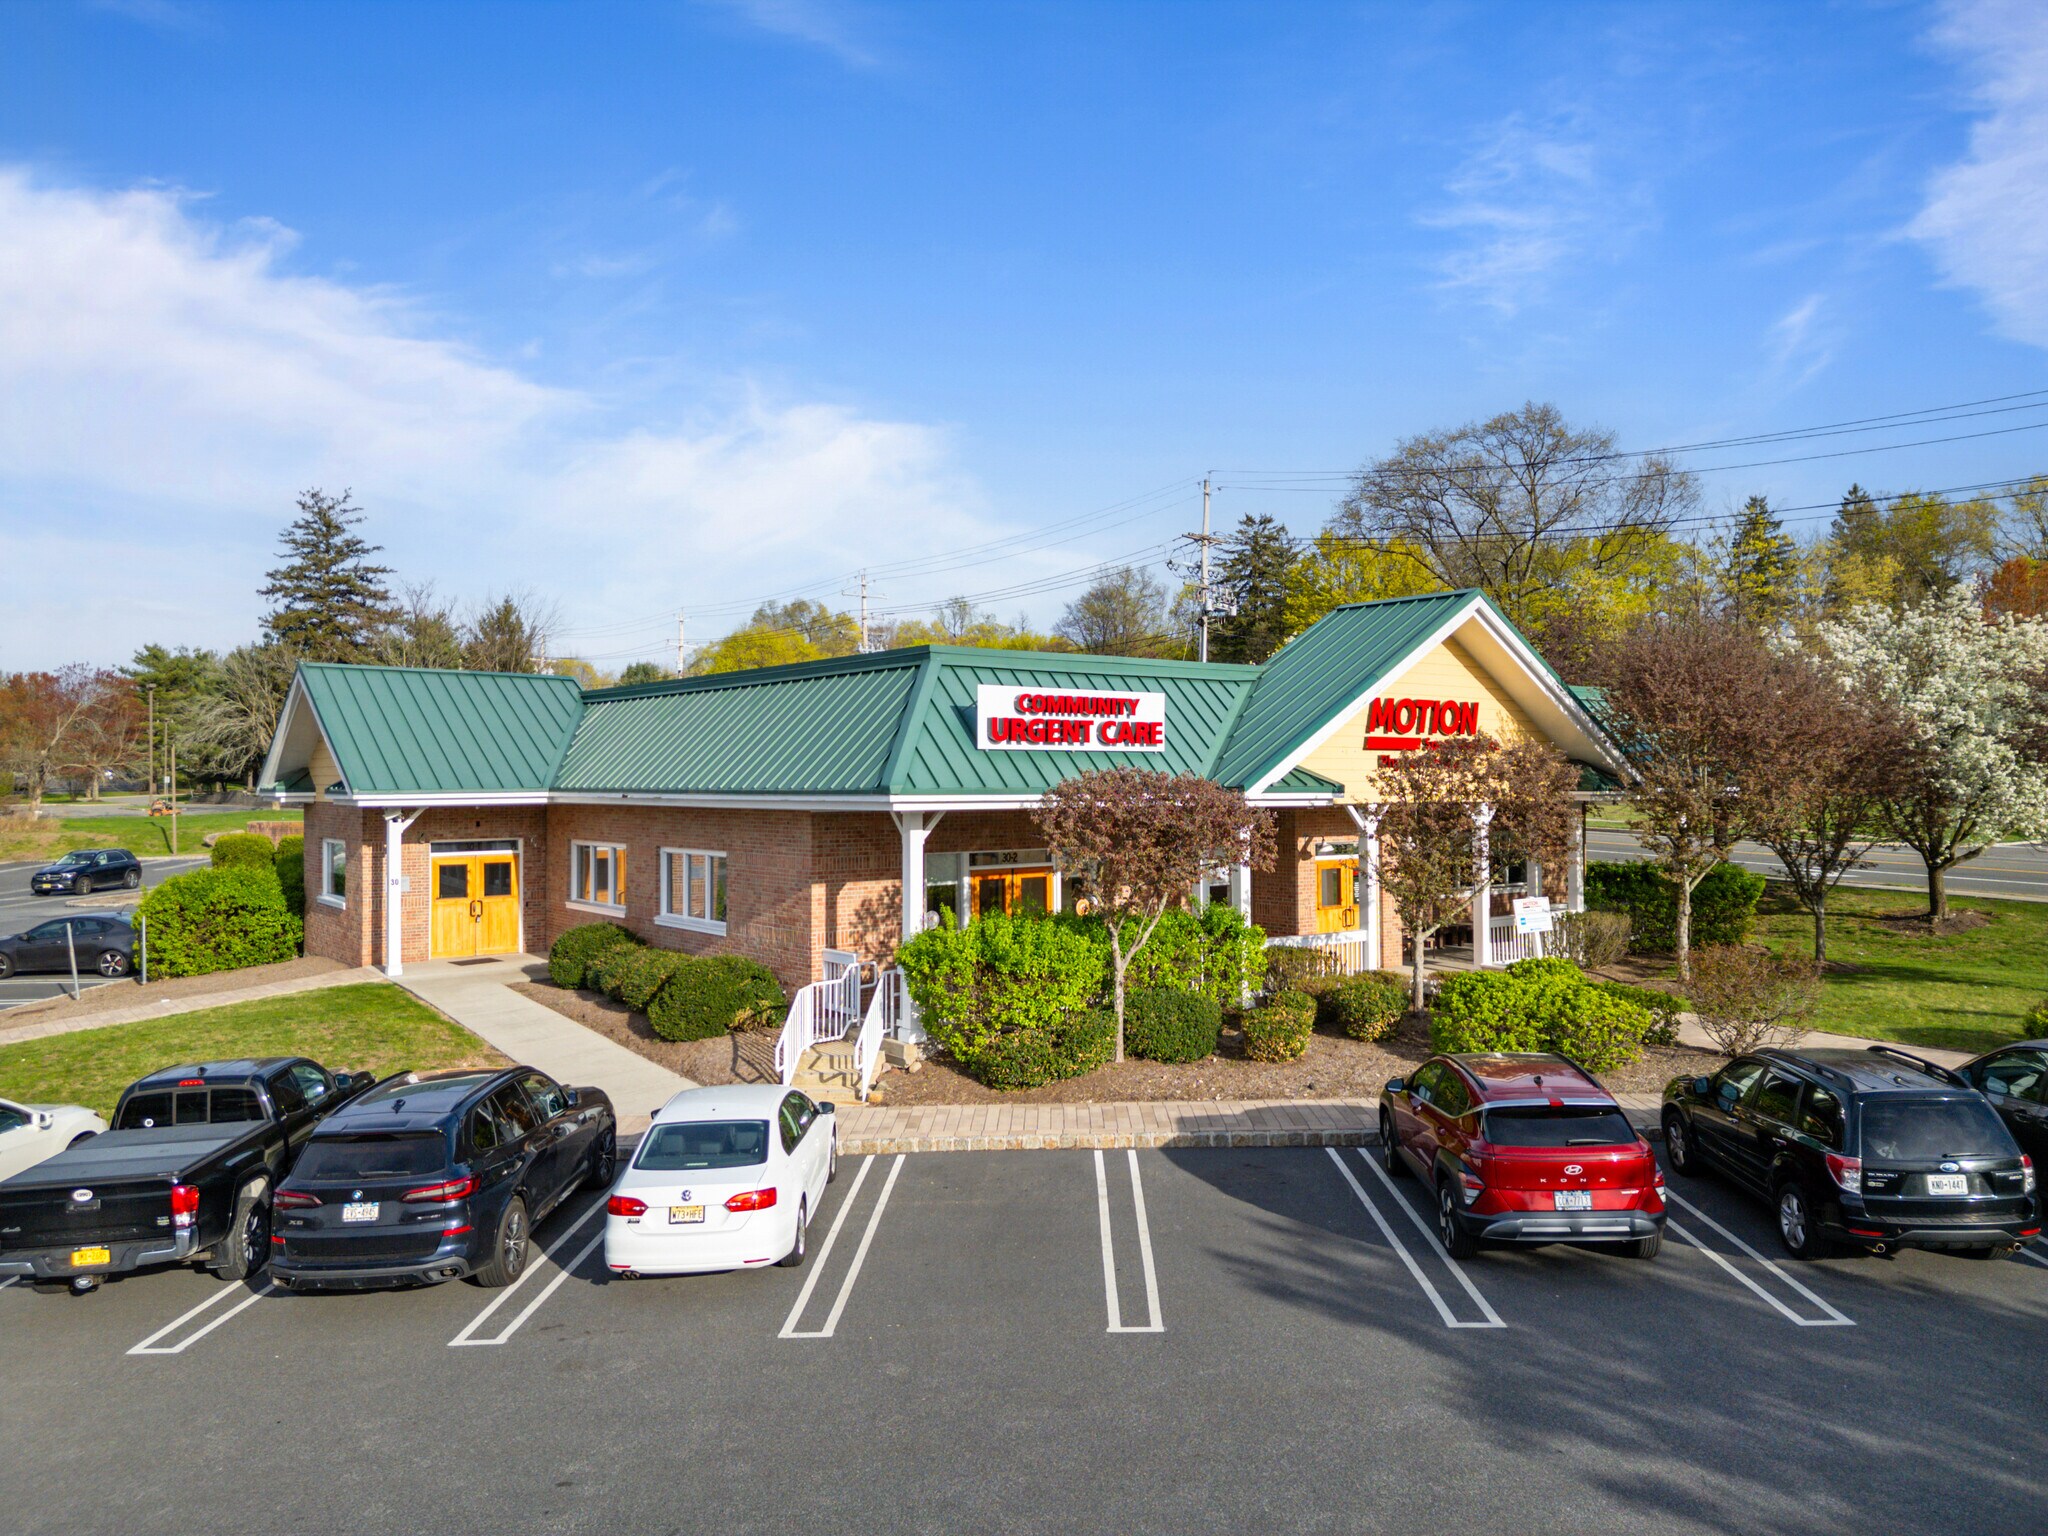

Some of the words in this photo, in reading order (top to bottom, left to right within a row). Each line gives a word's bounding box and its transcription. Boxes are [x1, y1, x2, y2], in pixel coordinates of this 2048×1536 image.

[1017, 693, 1140, 717] COMMUNITY
[1366, 697, 1480, 736] MOTION
[990, 717, 1094, 744] URGENT
[1100, 721, 1163, 744] CARE
[1002, 852, 1018, 863] 30-2
